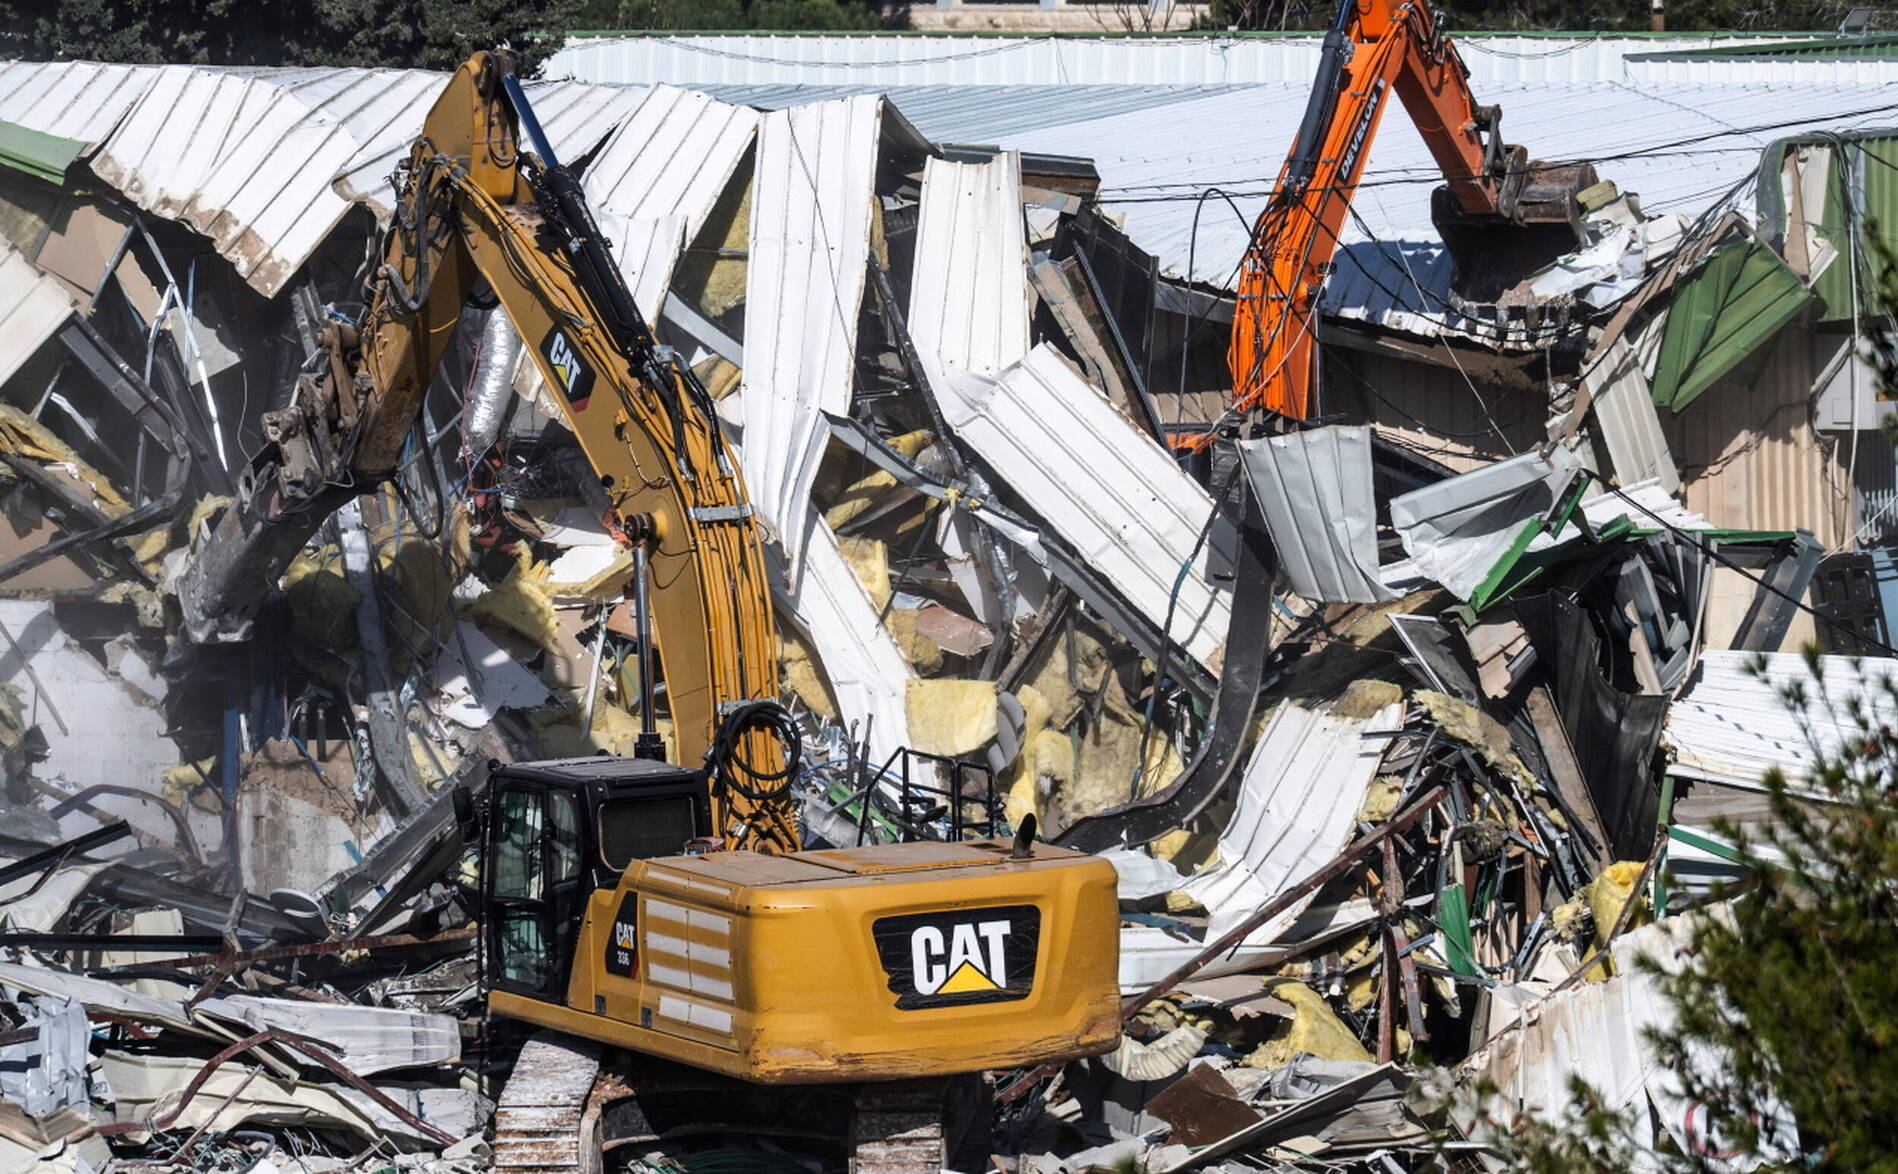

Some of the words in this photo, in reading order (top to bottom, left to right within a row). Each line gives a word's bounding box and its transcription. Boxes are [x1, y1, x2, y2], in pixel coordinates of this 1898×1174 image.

[1341, 92, 1378, 179] DEVELON
[550, 332, 581, 394] CAT
[616, 921, 635, 949] CAT
[911, 920, 1011, 995] CAT
